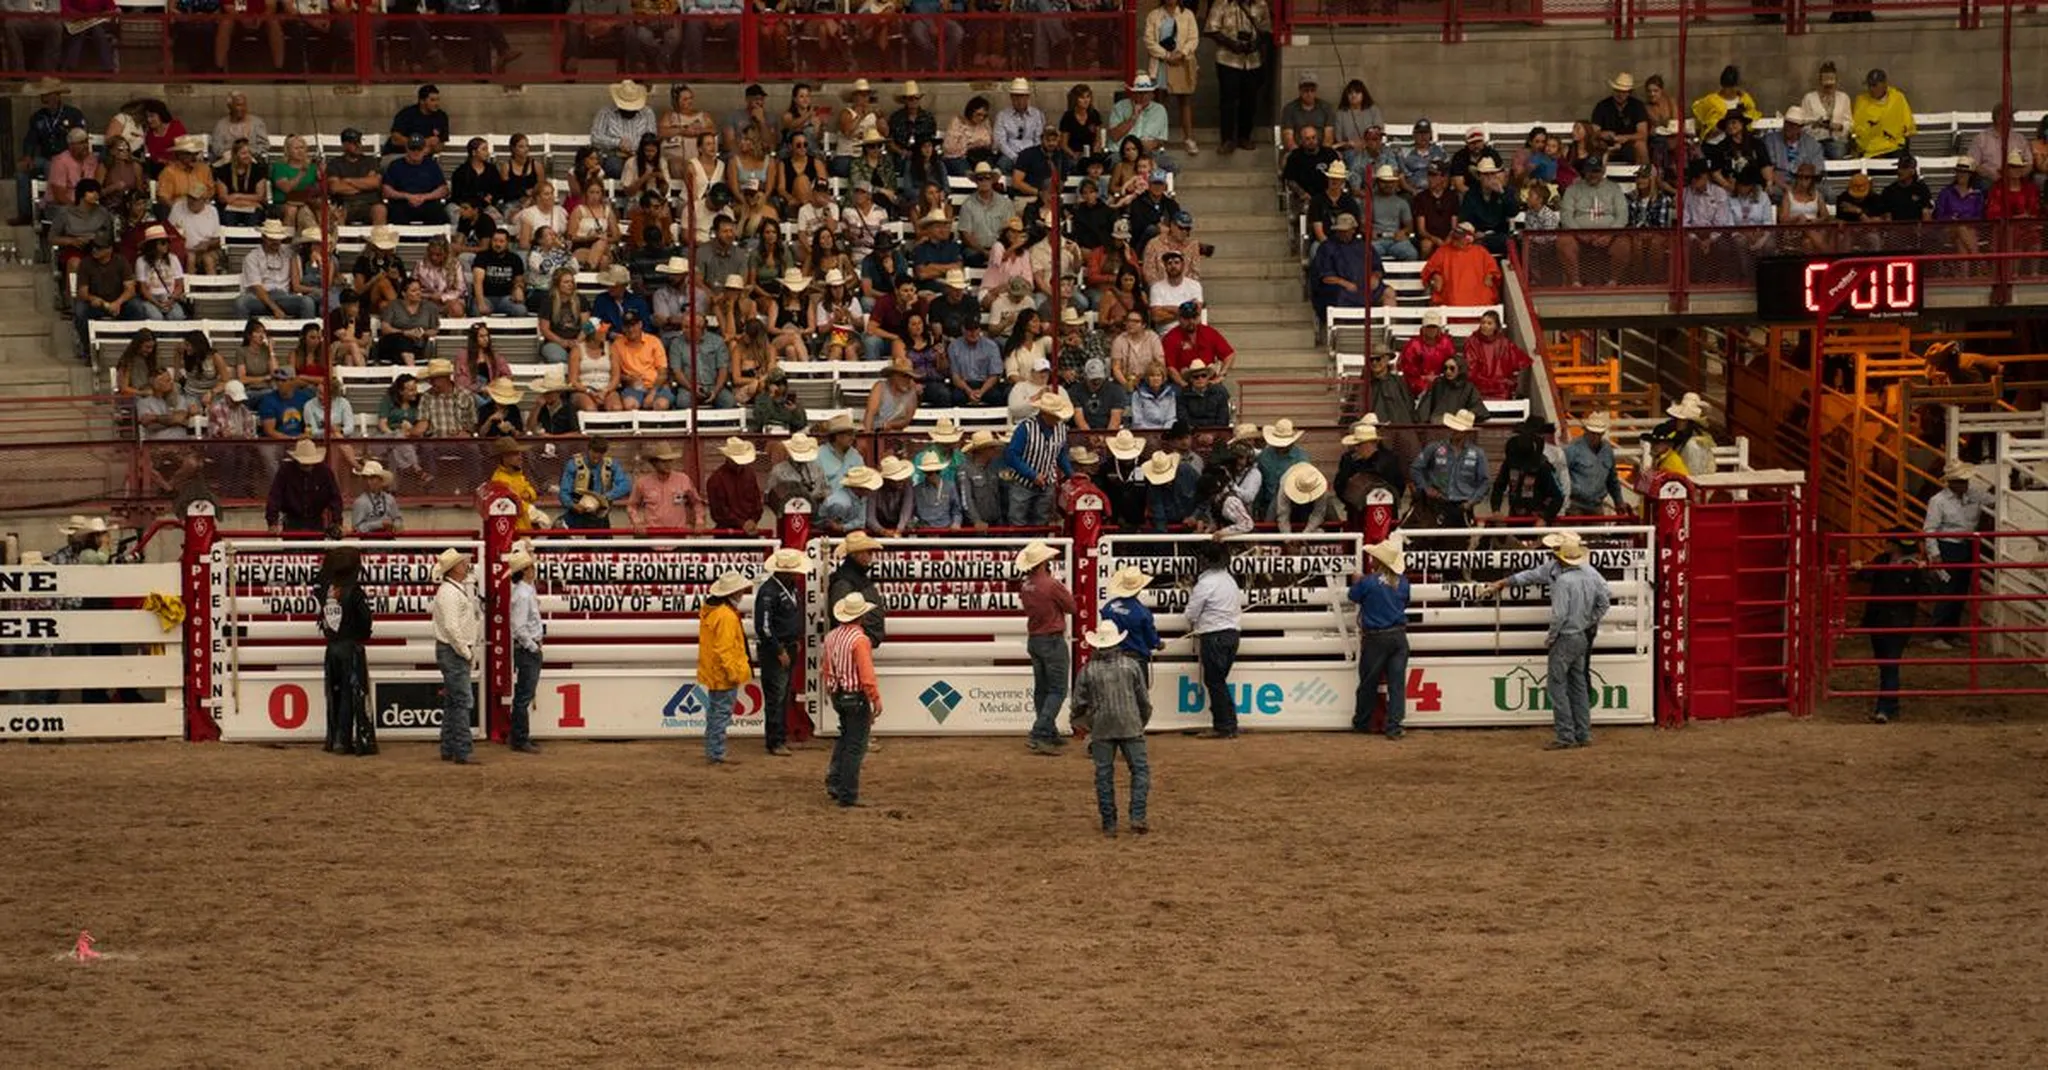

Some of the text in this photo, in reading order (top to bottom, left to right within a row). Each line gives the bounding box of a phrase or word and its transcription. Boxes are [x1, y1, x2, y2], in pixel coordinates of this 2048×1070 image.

[236, 565, 321, 582] HEYENNE
[537, 564, 617, 580] HEYENNE
[624, 564, 707, 580] FRONTIER
[921, 561, 1004, 578] FRONTIER
[1404, 552, 1494, 569] CHEYENNE
[1501, 552, 1555, 569] FRONT
[631, 596, 652, 611] OF
[927, 594, 948, 610] OF
[1510, 585, 1530, 599] OF
[1677, 528, 1686, 697] CHEYENNE
[211, 549, 223, 720] CHEYENNE
[806, 547, 818, 714] CHEYENNE
[1178, 675, 1284, 715] bue
[1407, 668, 1442, 711] 4
[1490, 676, 1629, 711] Unn
[268, 683, 309, 730] 0
[382, 703, 444, 726] devo
[556, 683, 585, 728] 1
